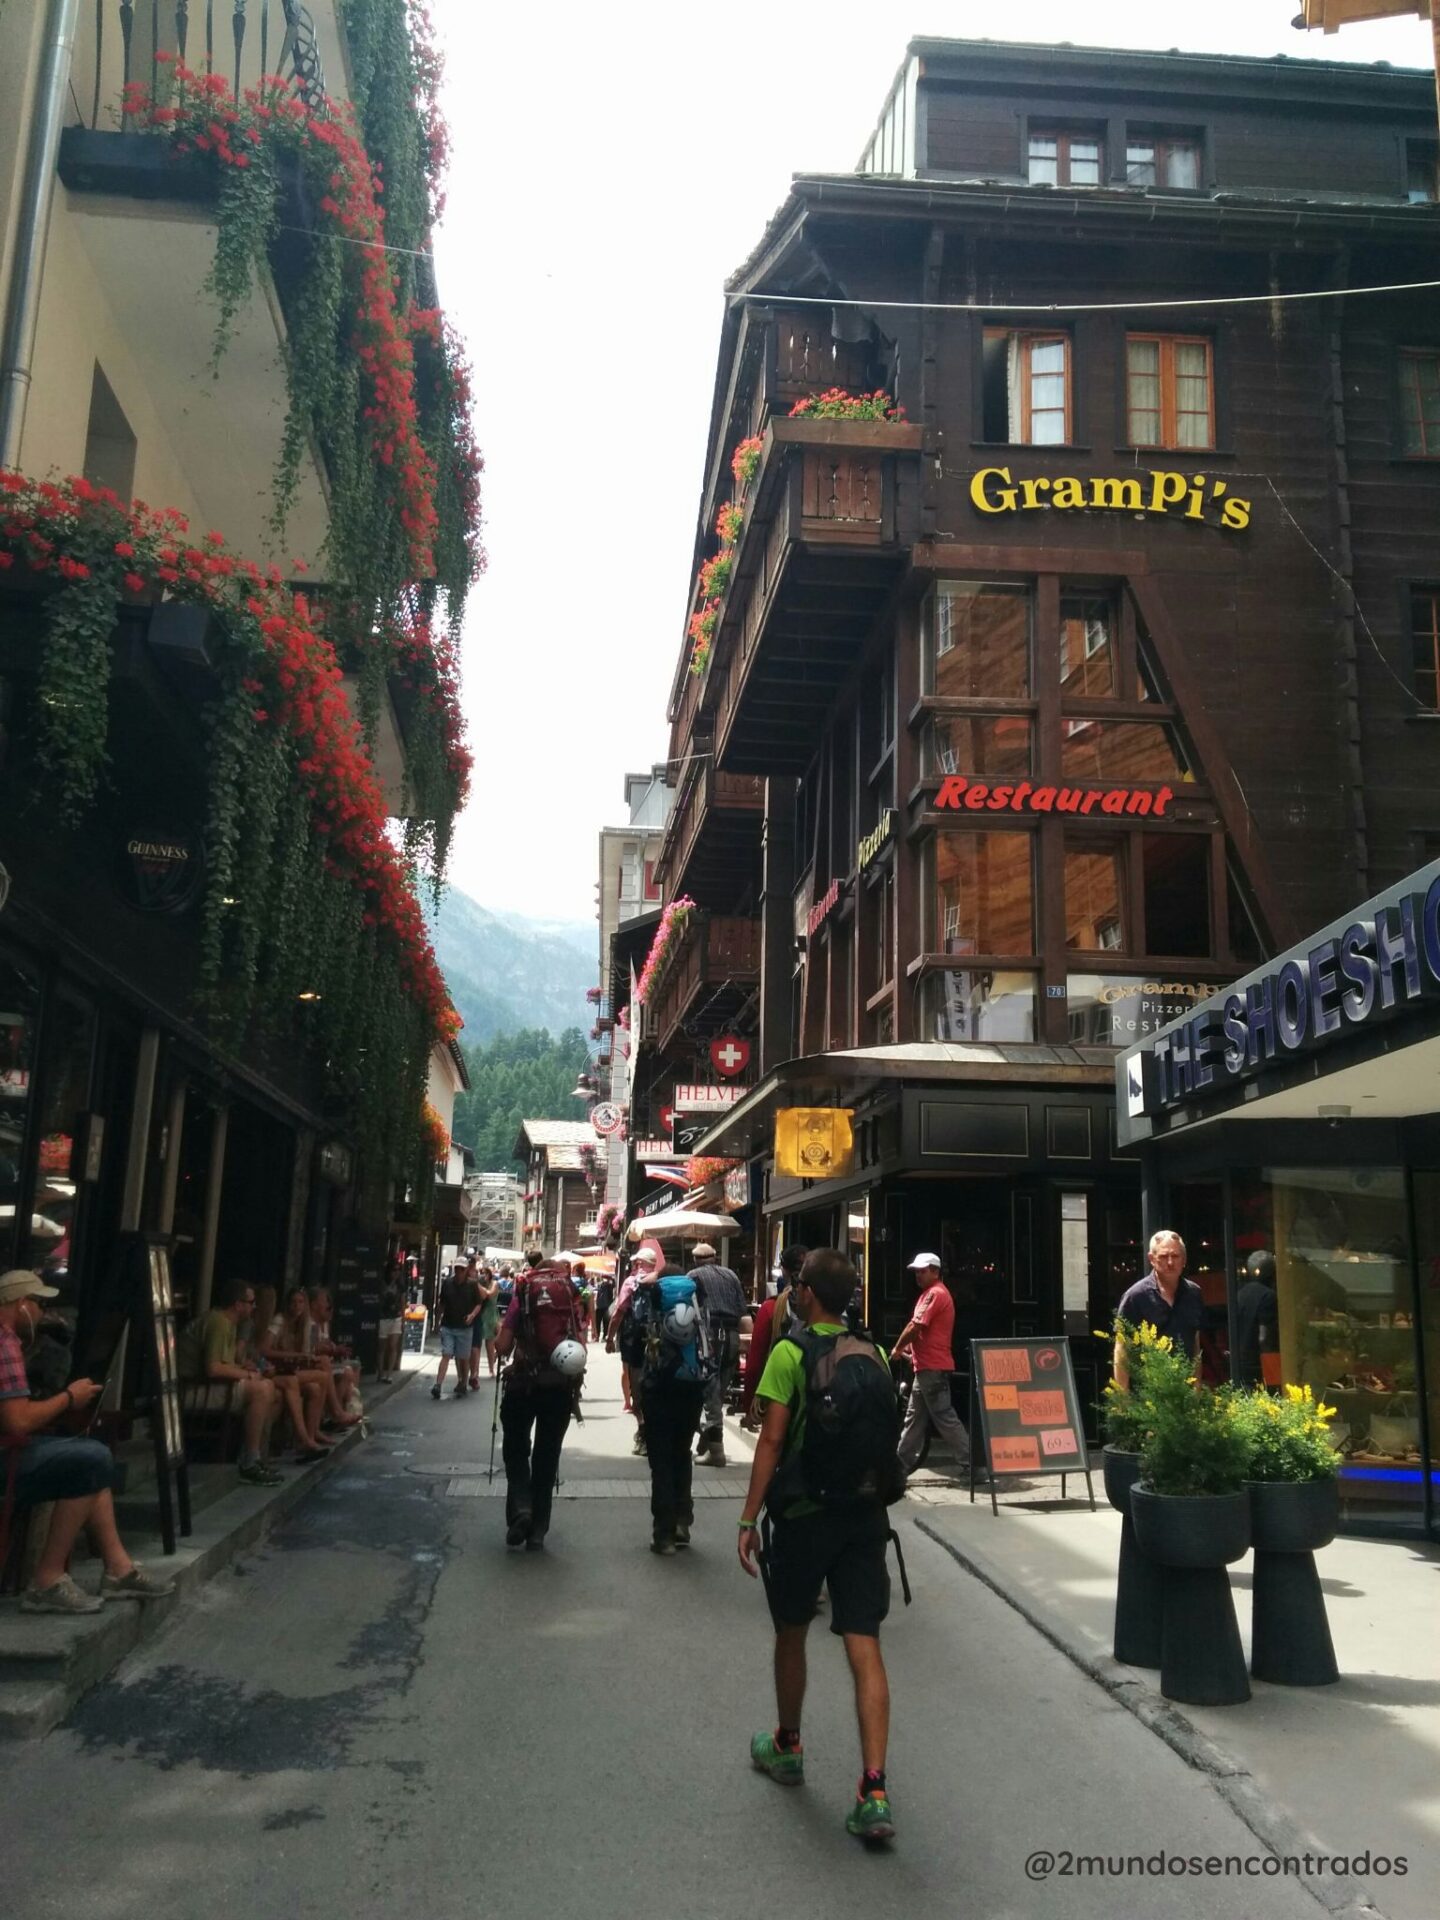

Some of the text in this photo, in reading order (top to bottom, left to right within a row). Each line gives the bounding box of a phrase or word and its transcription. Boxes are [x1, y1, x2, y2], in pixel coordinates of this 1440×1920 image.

[934, 775, 1173, 816] Restaurant
[1051, 987, 1061, 996] 70
[1112, 1015, 1168, 1031] Rest
[1154, 1010, 1214, 1104] THE
[1022, 1399, 1063, 1418] Sale
